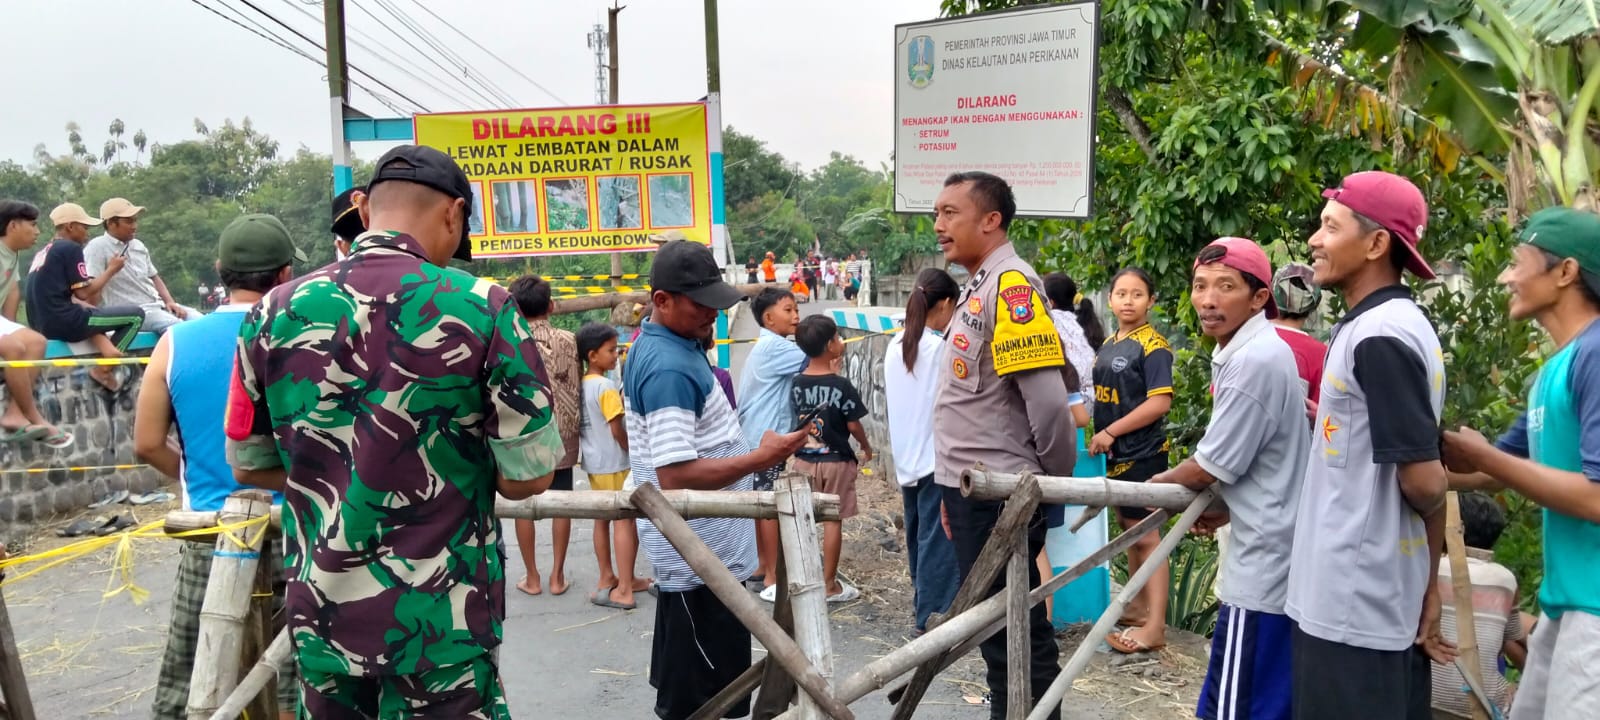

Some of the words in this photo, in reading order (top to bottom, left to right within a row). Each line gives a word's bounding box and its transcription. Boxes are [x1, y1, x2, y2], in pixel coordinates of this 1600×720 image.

[944, 36, 990, 51] PEMERINTAH
[991, 33, 1026, 48] PROVINSI
[1028, 31, 1049, 44] JAWA
[1051, 28, 1077, 42] TIMUR
[942, 58, 965, 71] DINAS
[966, 54, 1007, 68] KELAUTAN
[1009, 52, 1028, 65] DAN
[1029, 48, 1079, 63] PERIKANAN
[957, 94, 1017, 109] DILARANG
[472, 113, 617, 140] DILARANG
[902, 116, 949, 126] MENANGKAP
[951, 115, 970, 124] IKAN
[972, 114, 1006, 124] DENGAN
[1008, 111, 1078, 122] MENGGUNAKAN
[919, 129, 950, 138] SETRUM
[447, 144, 508, 160] LEWAT
[514, 139, 611, 157] JEMBATAN
[617, 137, 680, 154] DALAM
[919, 142, 957, 151] POTASIUM
[462, 161, 523, 176] ADAAN
[529, 157, 613, 175] DARURAT
[629, 154, 692, 170] RUSAK
[480, 236, 543, 251] PEMDES
